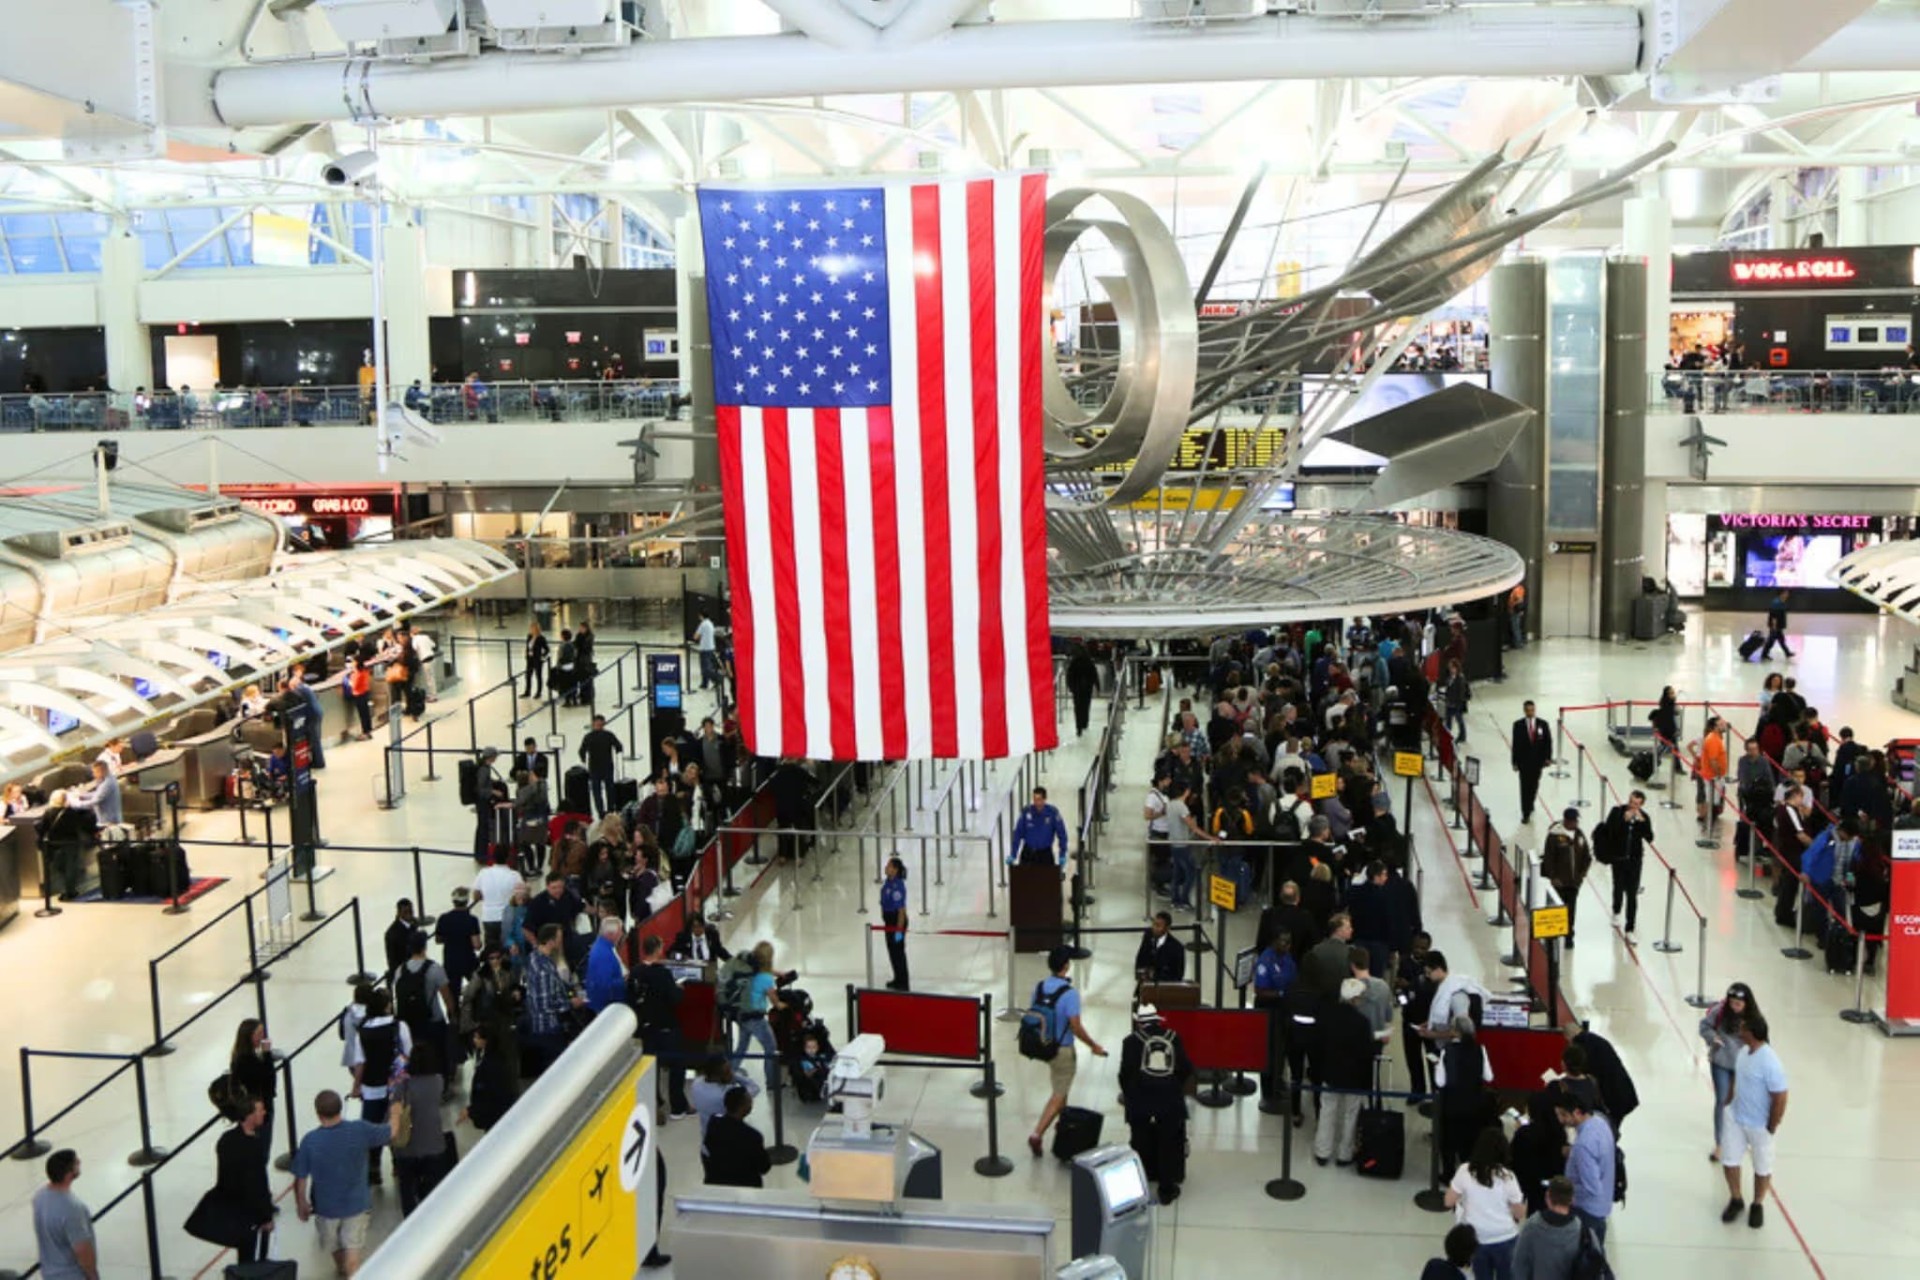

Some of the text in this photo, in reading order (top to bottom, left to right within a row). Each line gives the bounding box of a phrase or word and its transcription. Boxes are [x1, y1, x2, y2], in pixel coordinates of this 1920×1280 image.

[1734, 262, 1783, 279] WOK
[1720, 513, 1872, 528] VICTORIA'S SECRET
